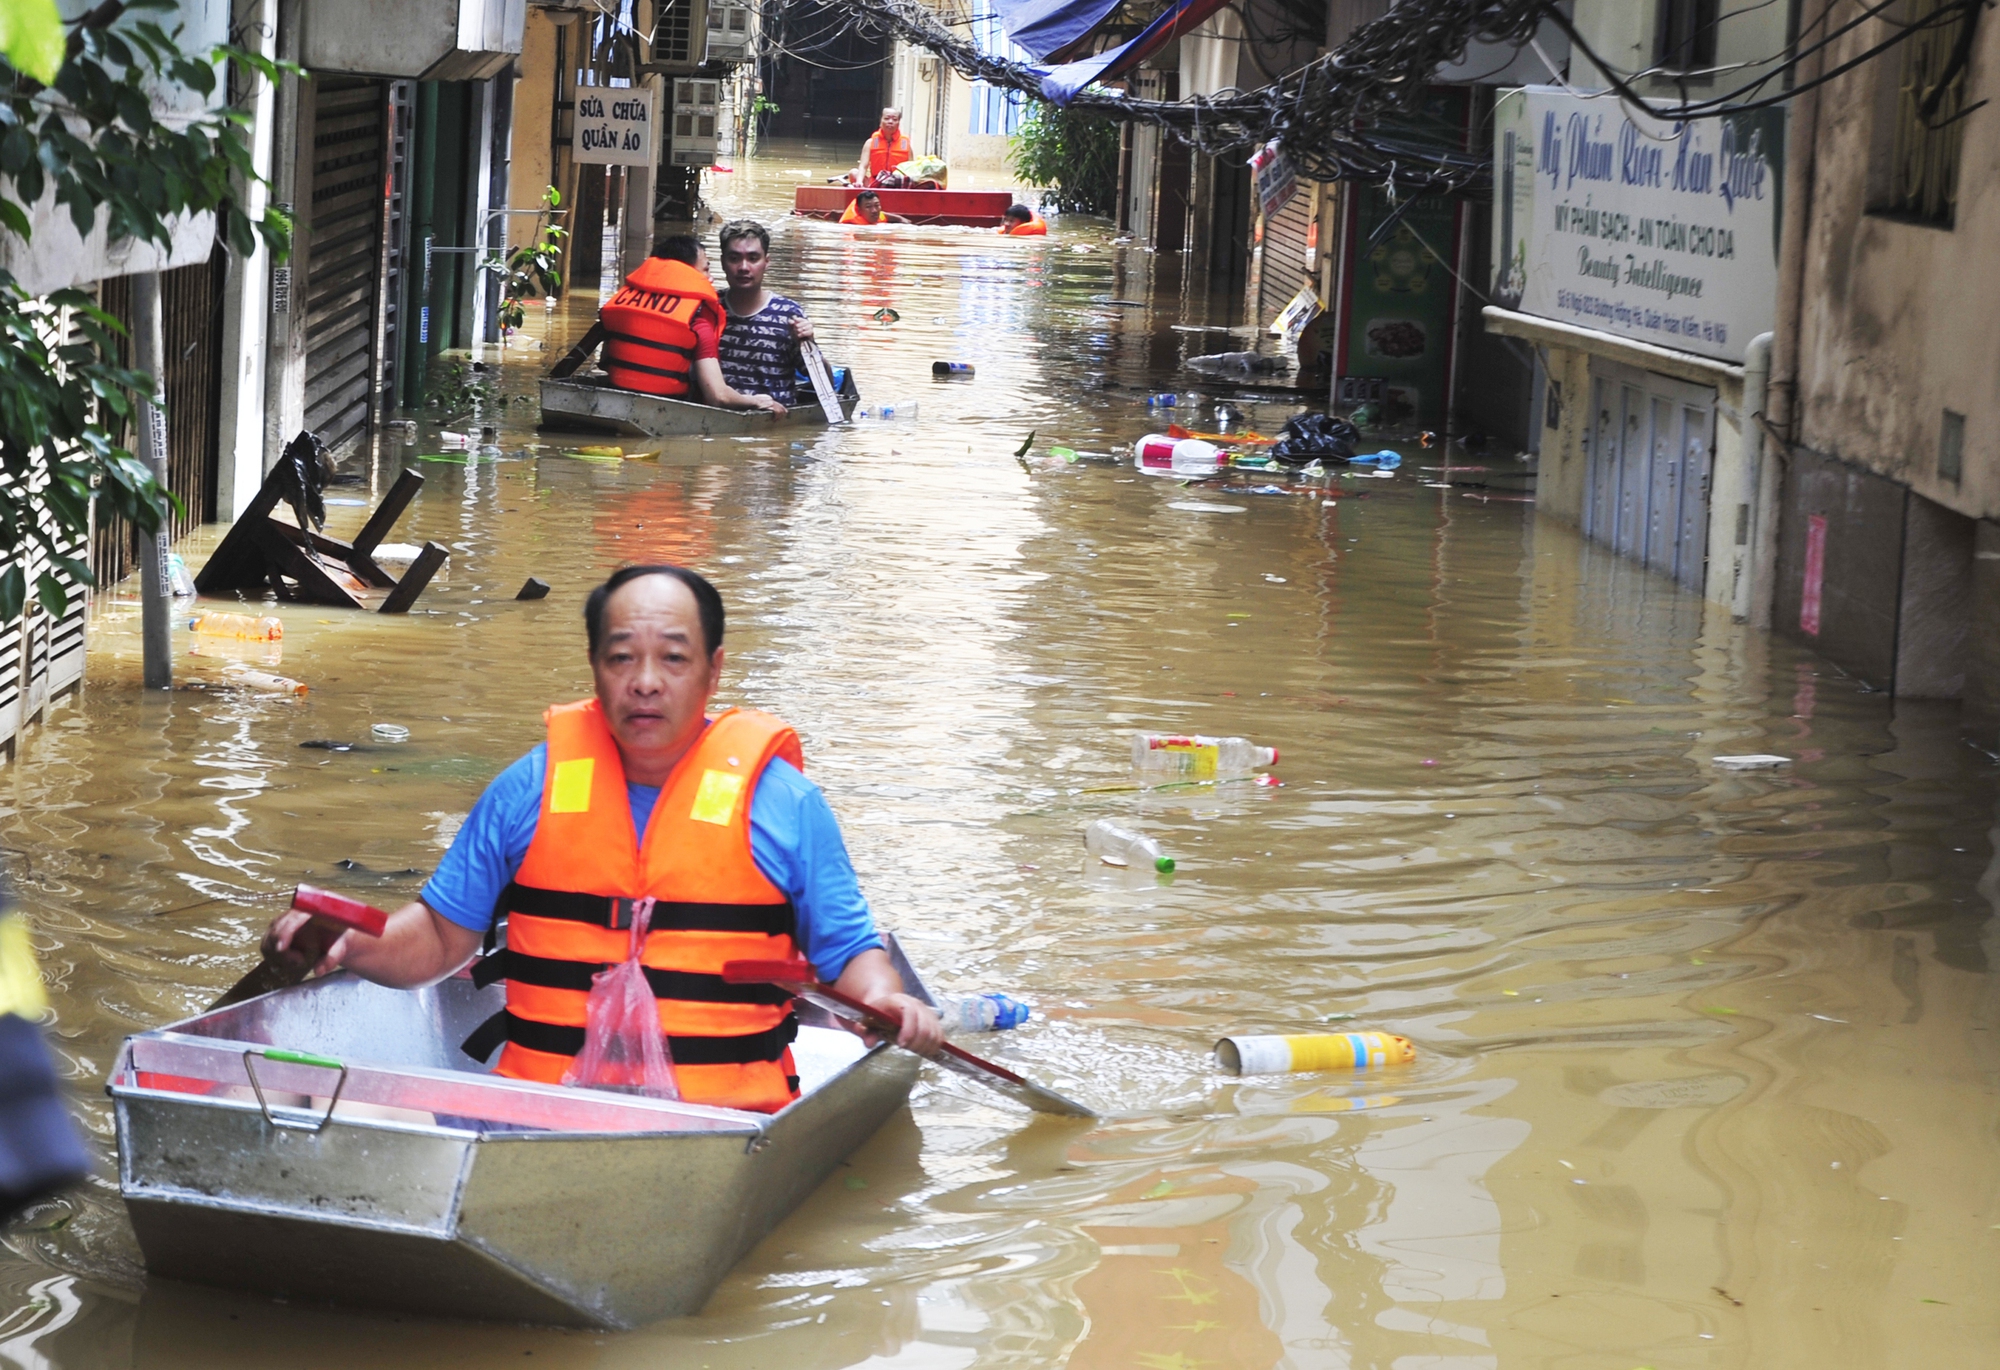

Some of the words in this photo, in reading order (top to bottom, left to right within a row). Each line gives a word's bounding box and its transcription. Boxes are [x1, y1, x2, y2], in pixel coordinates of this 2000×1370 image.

[580, 95, 605, 118] SỬA
[612, 98, 647, 122] CHỮA
[582, 123, 618, 151] QUẦN
[621, 128, 641, 151] ÁO
[1570, 193, 1599, 238] PHẨM
[1600, 210, 1629, 247] SẠCH
[1637, 218, 1654, 248] AN
[1656, 213, 1686, 253] TOÀN
[1689, 224, 1714, 257] CHO
[1717, 228, 1735, 260] DA
[1578, 245, 1620, 289] Beauty
[1624, 253, 1703, 300] Intelligence
[614, 285, 681, 314] CAND
